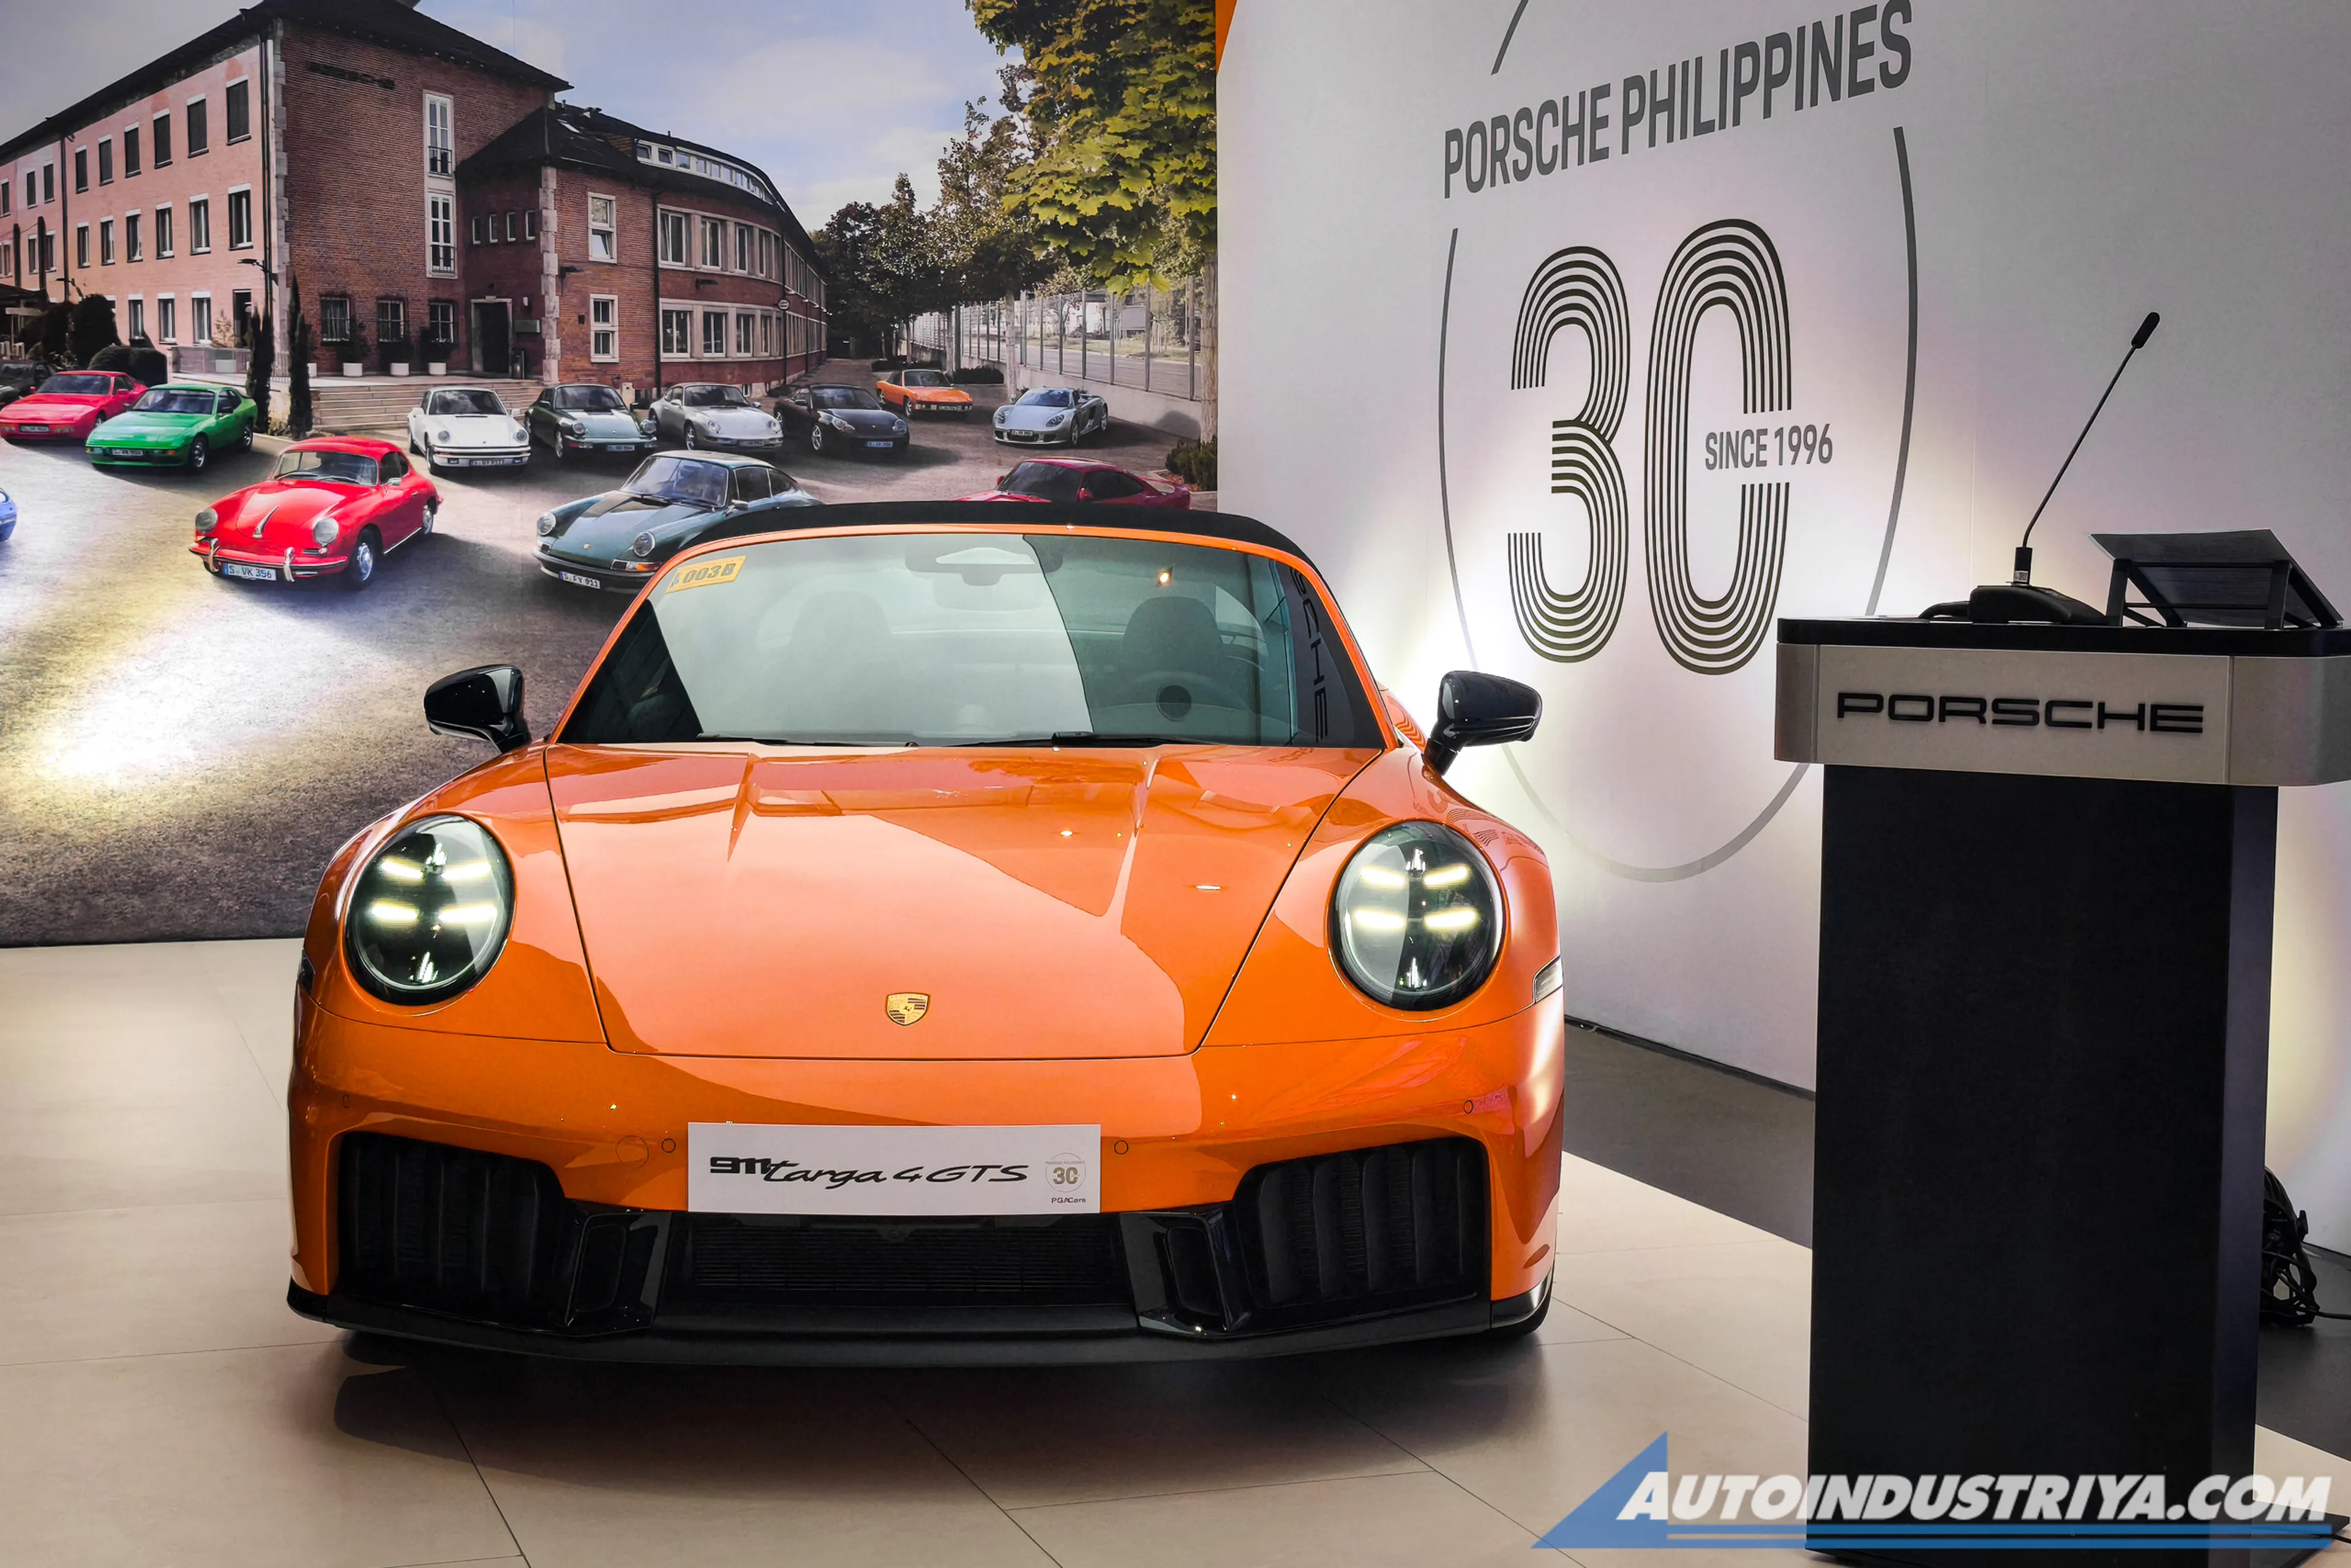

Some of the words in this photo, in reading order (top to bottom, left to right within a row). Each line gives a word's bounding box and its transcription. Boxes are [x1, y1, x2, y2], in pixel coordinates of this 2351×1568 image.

[1444, 83, 1611, 199] PORSCHE
[1622, 0, 1912, 154] PHILIPPINES
[1507, 219, 1792, 676] 30
[1705, 427, 1768, 470] SINCE
[1774, 423, 1832, 465] 1996
[229, 565, 235, 574] S
[241, 567, 253, 577] VK
[256, 568, 272, 579] 356
[1837, 692, 2204, 733] PORSCHE
